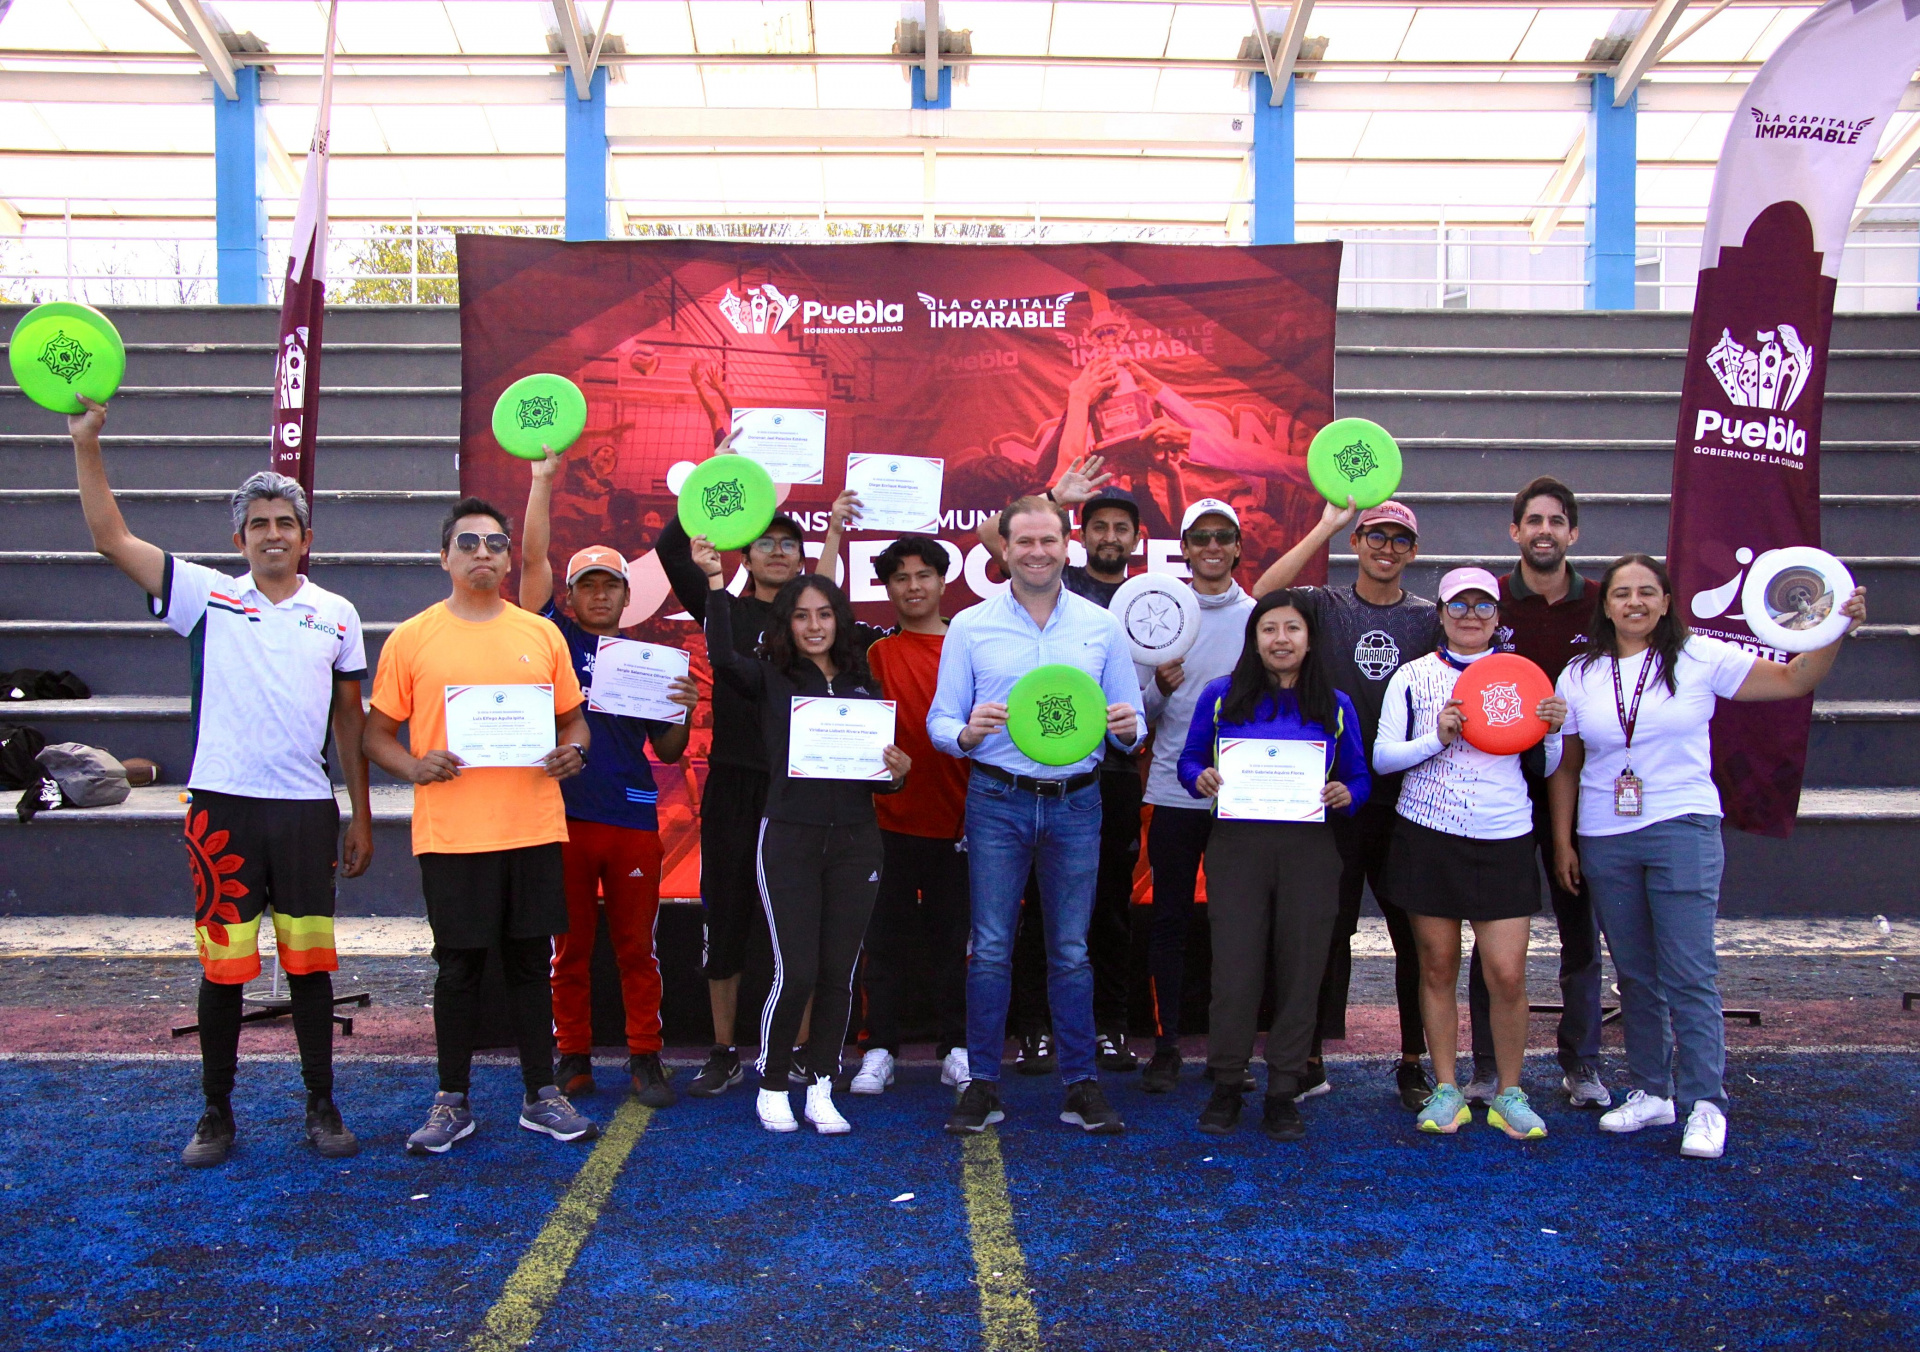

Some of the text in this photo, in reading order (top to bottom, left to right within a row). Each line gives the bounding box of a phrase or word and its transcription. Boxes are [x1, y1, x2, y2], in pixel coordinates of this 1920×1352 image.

[1764, 114, 1854, 129] LA CAPITAL
[1755, 124, 1861, 144] IMPARABLE
[803, 299, 904, 324] Puebla
[939, 299, 1054, 309] LA CAPITAL
[930, 311, 1066, 328] IMPARABLE
[871, 325, 903, 333] CIUDAD
[1694, 409, 1806, 456] Puebla
[1693, 446, 1804, 470] GOBIERNO DE LA CIUDAD
[1688, 626, 1724, 638] INSTITUTO
[1356, 649, 1398, 665] WARRIORS
